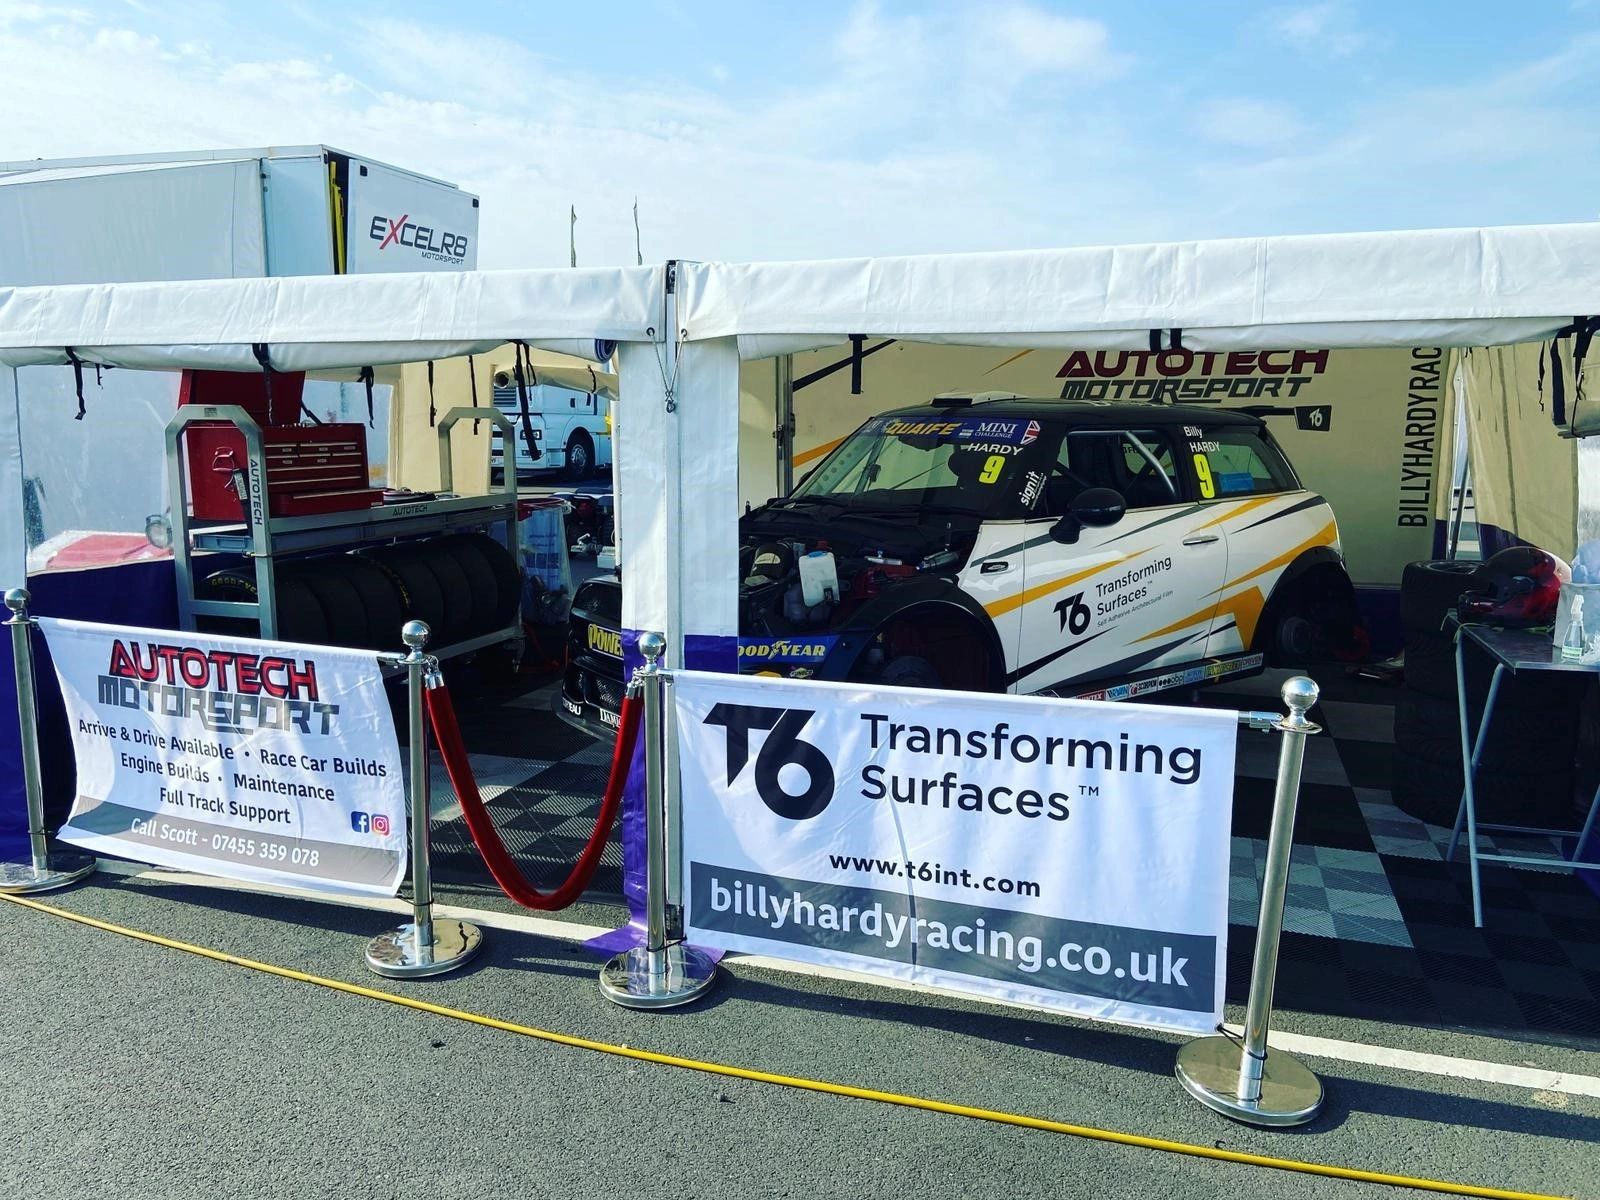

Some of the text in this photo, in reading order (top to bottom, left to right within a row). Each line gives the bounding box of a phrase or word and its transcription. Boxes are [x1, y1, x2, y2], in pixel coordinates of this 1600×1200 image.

[370, 214, 468, 258] EXCELR8
[421, 251, 465, 265] MOTORSPORT
[1055, 349, 1330, 378] AUTOTECH
[1060, 376, 1312, 403] MOTORSPORT
[886, 422, 962, 435] QUAIFE
[974, 431, 1013, 439] CHALLENGE
[976, 422, 1019, 434] MINI
[1183, 426, 1203, 439] Billy
[1189, 441, 1220, 453] HARDY
[967, 443, 1024, 456] HARDY
[979, 455, 1006, 484] 9
[250, 459, 262, 526] AUTOTECH
[1193, 453, 1215, 498] 9
[393, 504, 428, 516] AUTOTECH
[1096, 556, 1172, 597] Transforming
[1053, 591, 1091, 636] T6
[1097, 586, 1147, 616] Surfaces
[108, 639, 319, 701] AUTOTECH
[738, 643, 826, 658] OODYEAR
[98, 675, 339, 735] MOTORSPORT
[79, 719, 387, 777] Arrive & Drive Available Race Car Builds
[703, 703, 834, 820] T6
[860, 713, 1202, 785] Transforming
[121, 752, 335, 801] Engine Builds Maintenance
[860, 764, 1071, 822] Surfaces
[160, 788, 291, 824] Full Track Support
[131, 818, 157, 838] Call
[160, 823, 198, 846] Scott
[212, 834, 255, 856] 07455
[259, 842, 287, 862] 359
[291, 847, 319, 867] 078
[829, 854, 1040, 898] www.t6int.com
[710, 878, 1189, 988] billyhardyracing.co.uk
